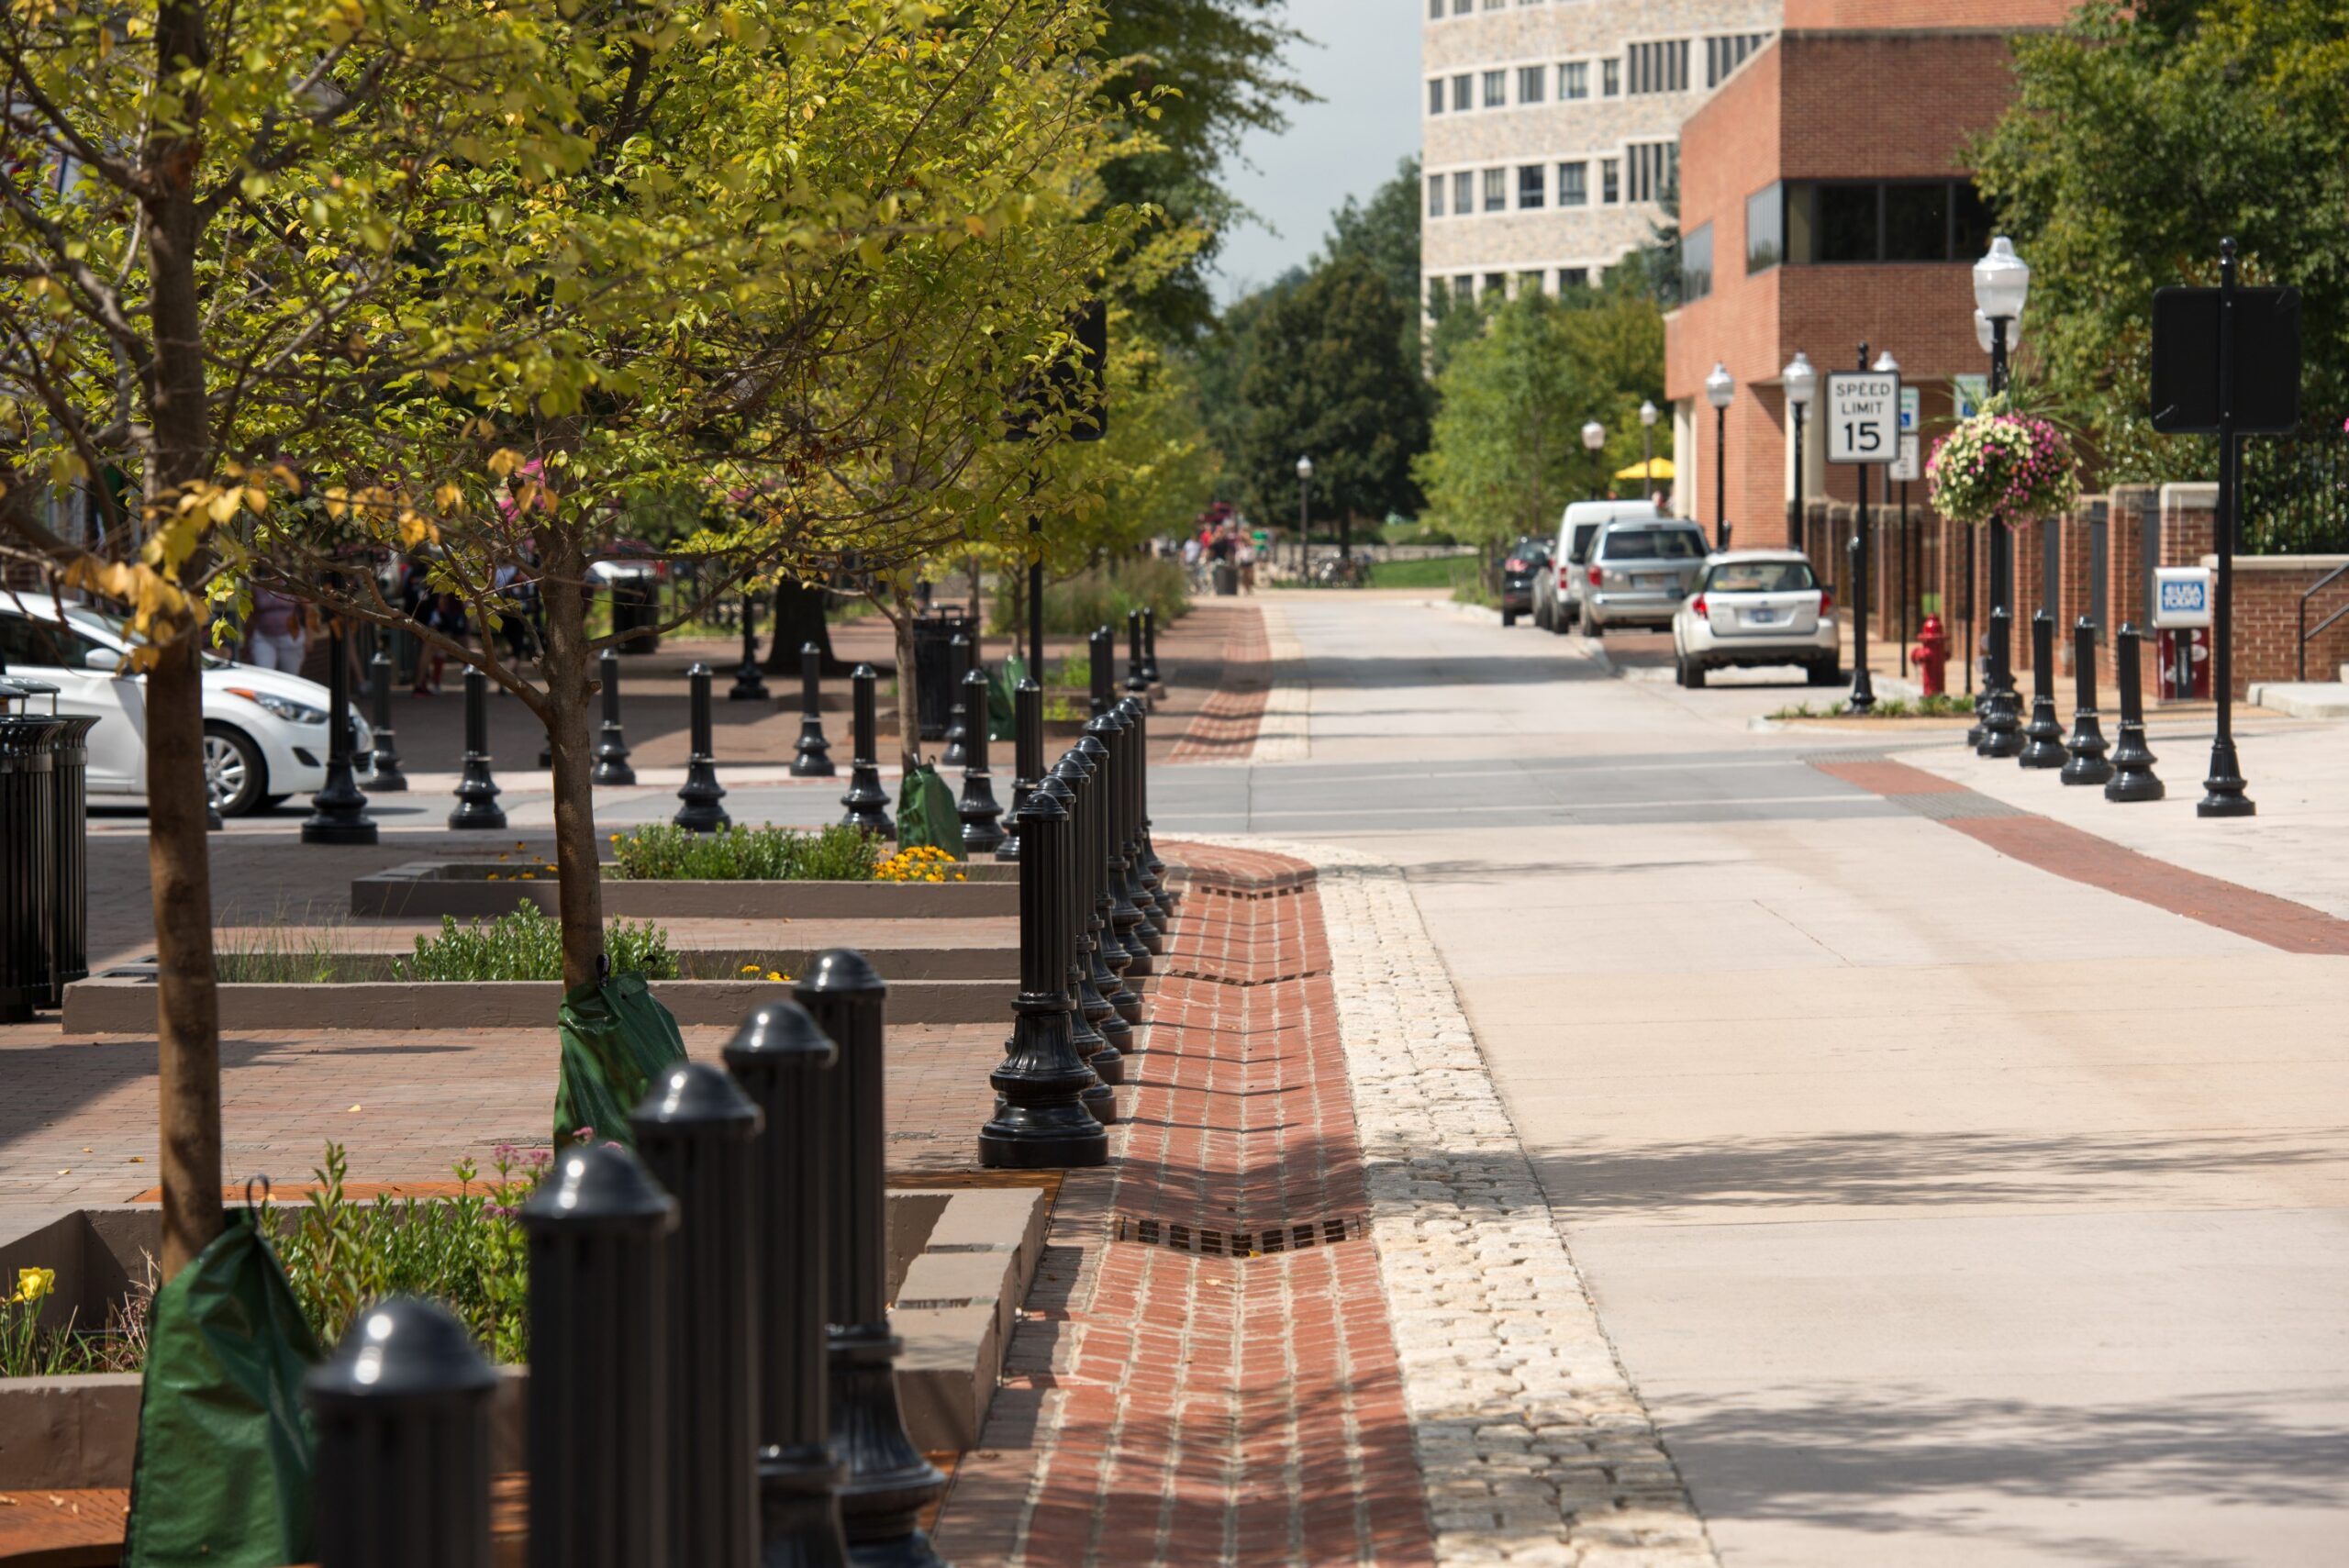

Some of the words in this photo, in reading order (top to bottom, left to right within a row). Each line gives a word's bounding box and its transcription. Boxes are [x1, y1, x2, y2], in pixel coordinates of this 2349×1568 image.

[1836, 383, 1890, 396] SPEED
[1842, 401, 1883, 415] LIMIT
[1844, 422, 1880, 451] 15
[2176, 584, 2202, 596] USA
[2165, 595, 2202, 607] TODAY
